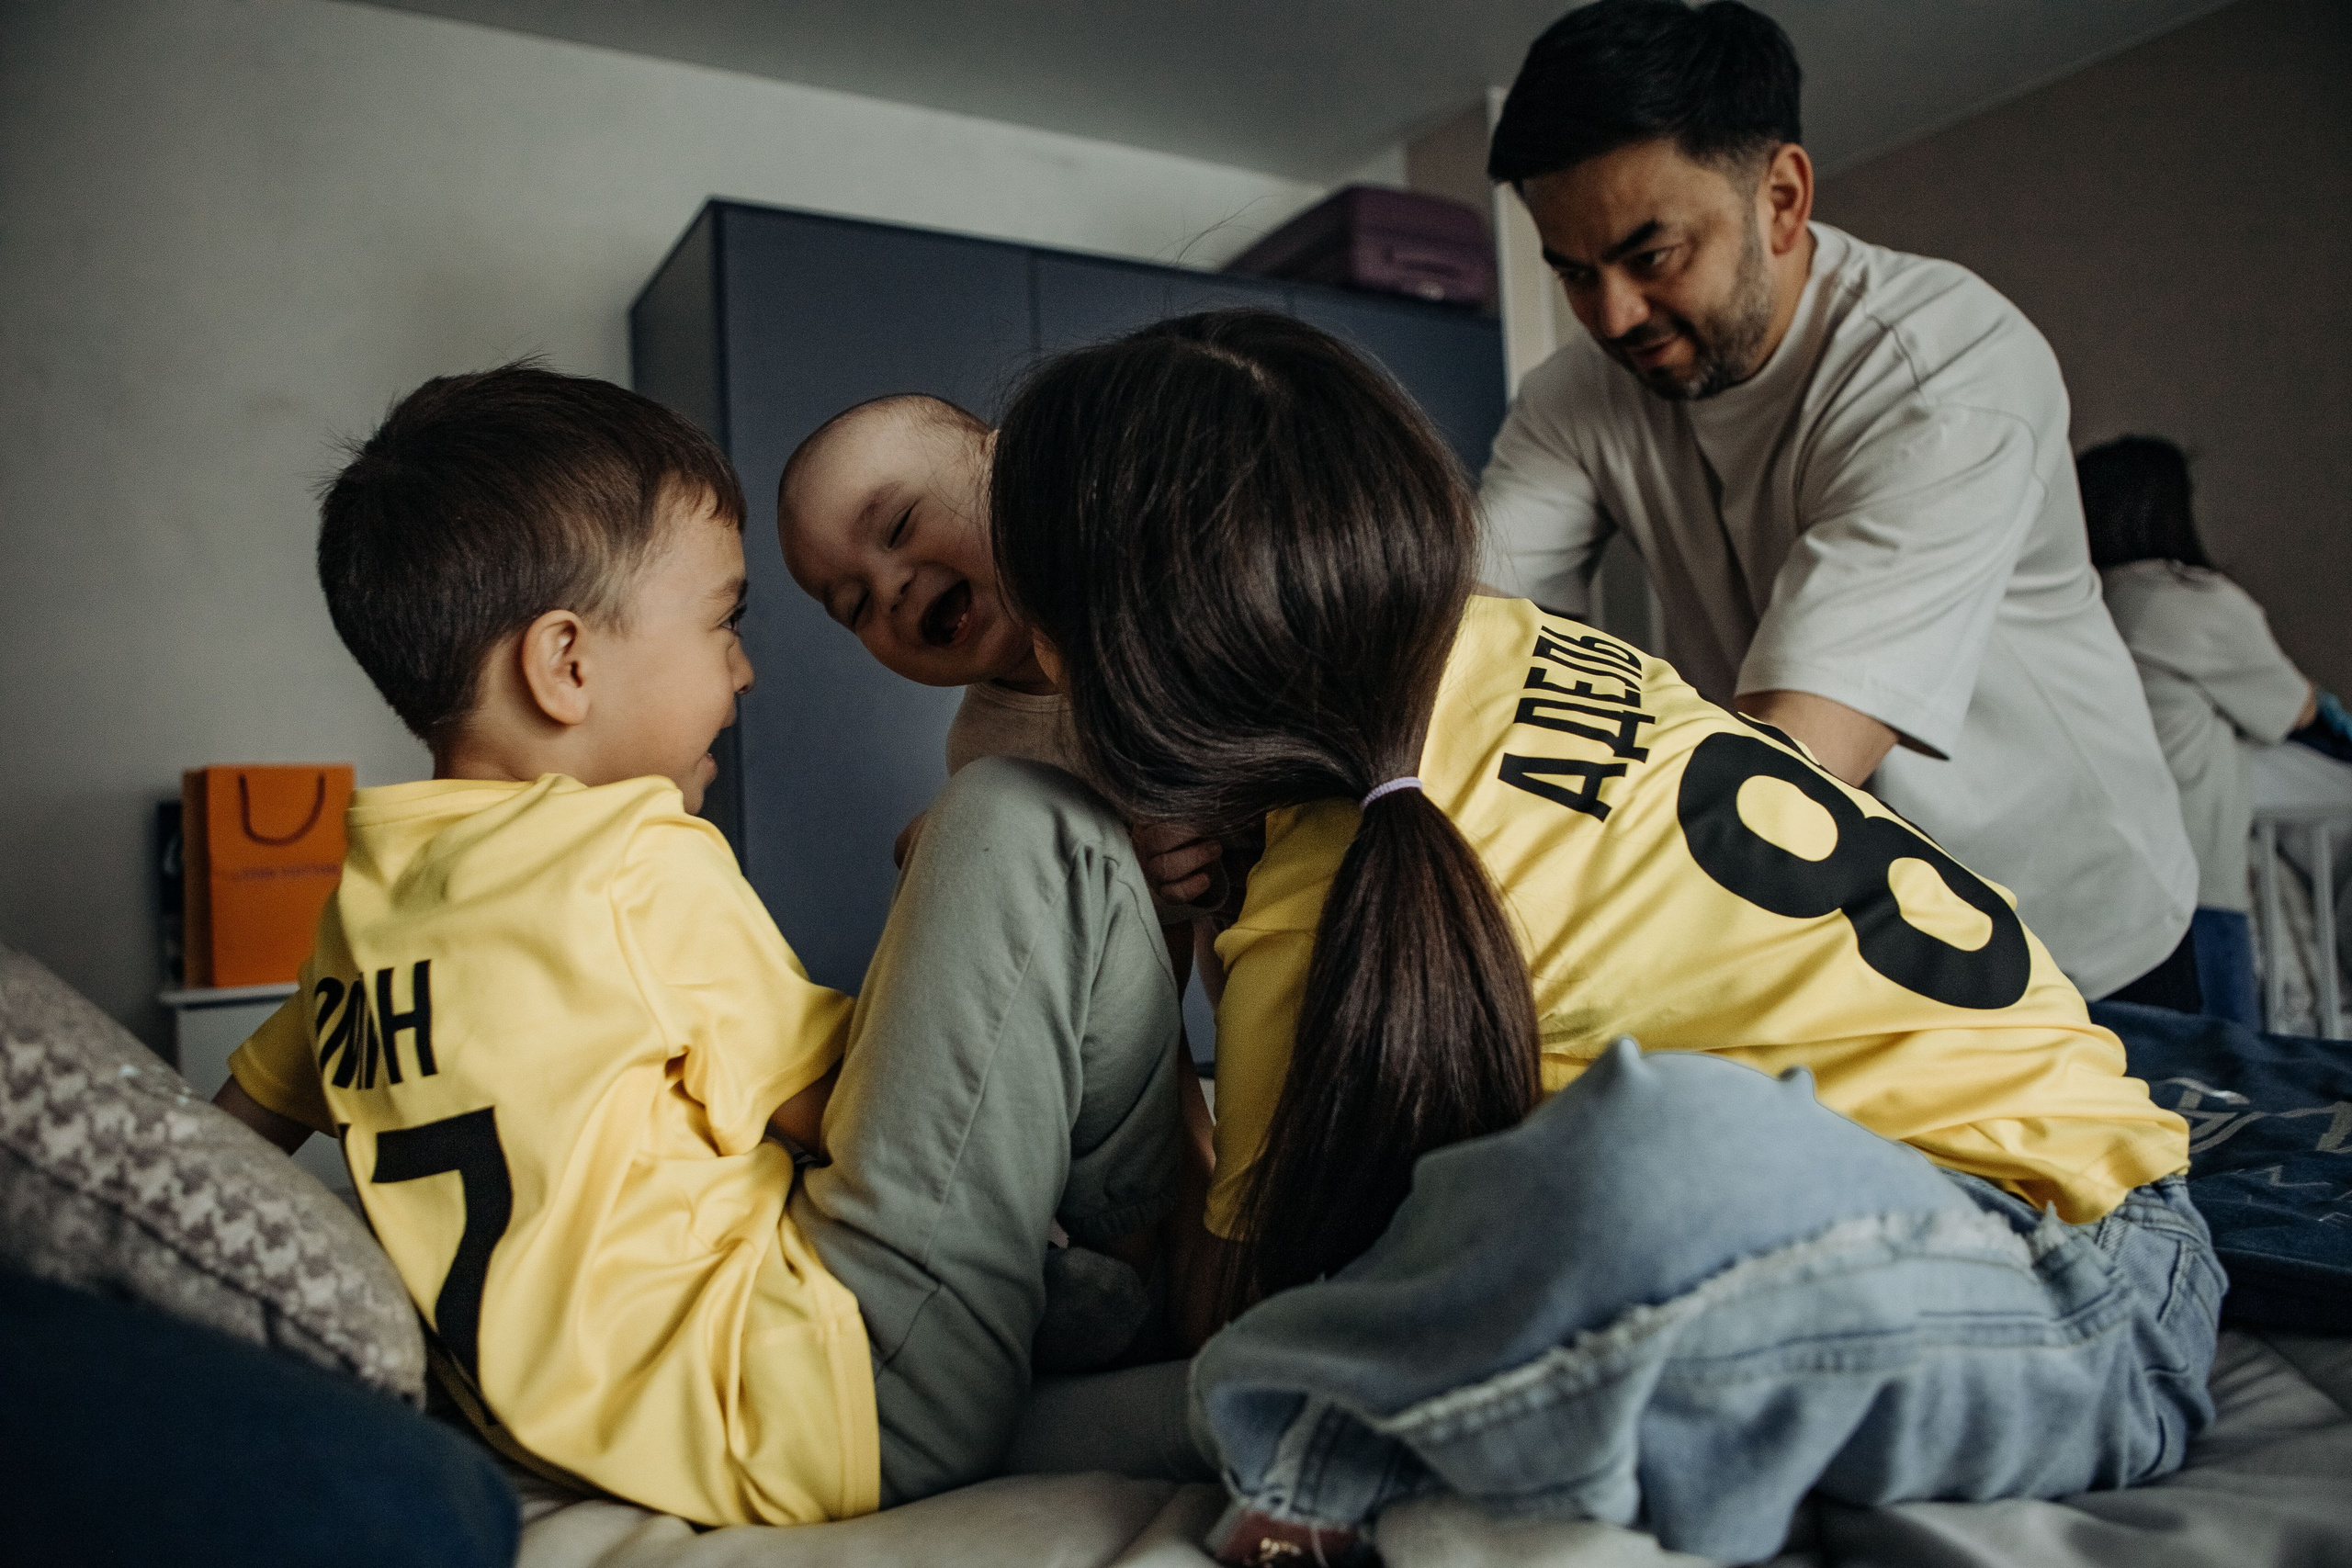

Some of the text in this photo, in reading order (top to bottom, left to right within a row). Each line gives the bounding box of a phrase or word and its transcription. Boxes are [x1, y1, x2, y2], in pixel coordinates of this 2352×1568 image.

[1498, 626, 1656, 822] АДЕЛЬ
[1677, 714, 2032, 1010] 8
[338, 1104, 514, 1389] 7
